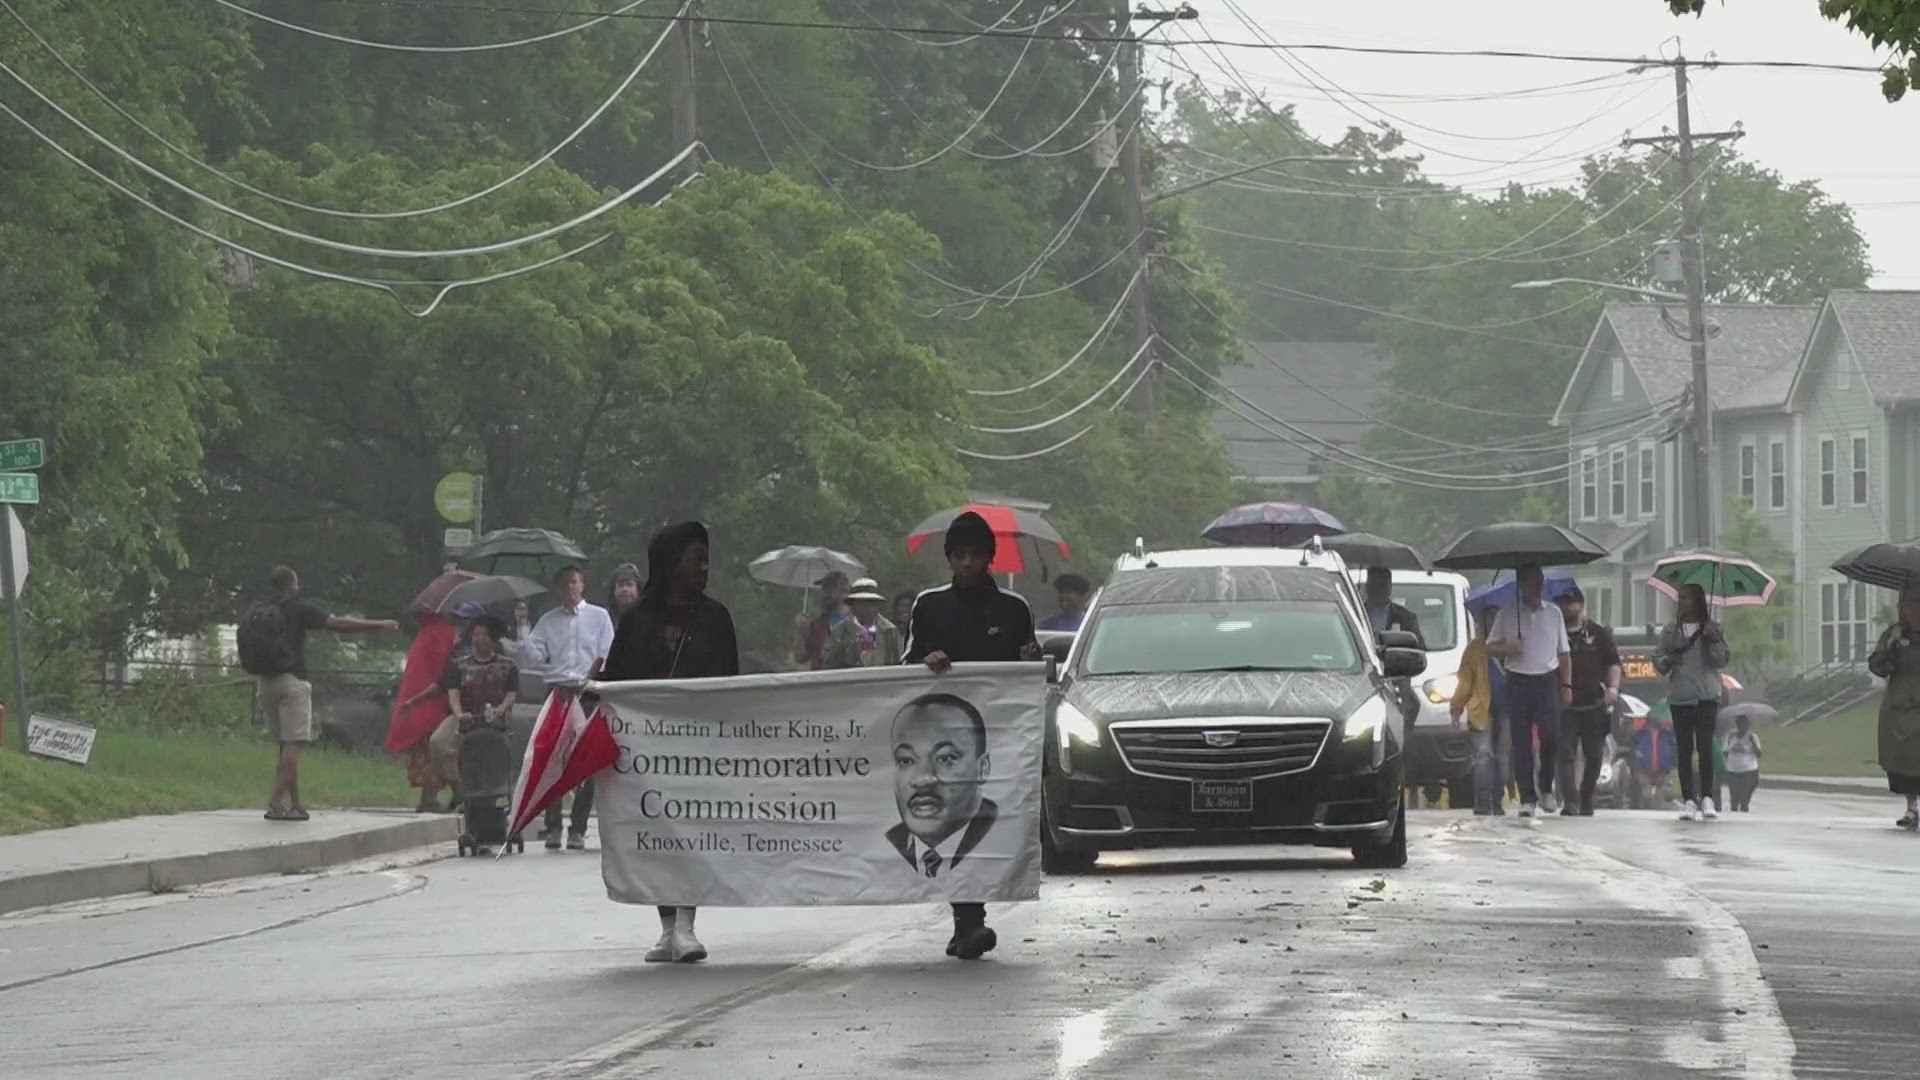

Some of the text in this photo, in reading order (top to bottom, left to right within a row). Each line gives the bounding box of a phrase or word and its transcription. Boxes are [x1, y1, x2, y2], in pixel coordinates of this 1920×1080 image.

[14, 455, 31, 466] 100
[611, 718, 635, 735] Dr.
[644, 719, 710, 738] Martin
[718, 720, 782, 739] Luther
[787, 718, 840, 743] King,
[613, 746, 870, 777] Commemorative
[640, 788, 838, 821] Commission
[1204, 797, 1214, 808] &
[636, 831, 844, 856] Knoxville, Tennessee
